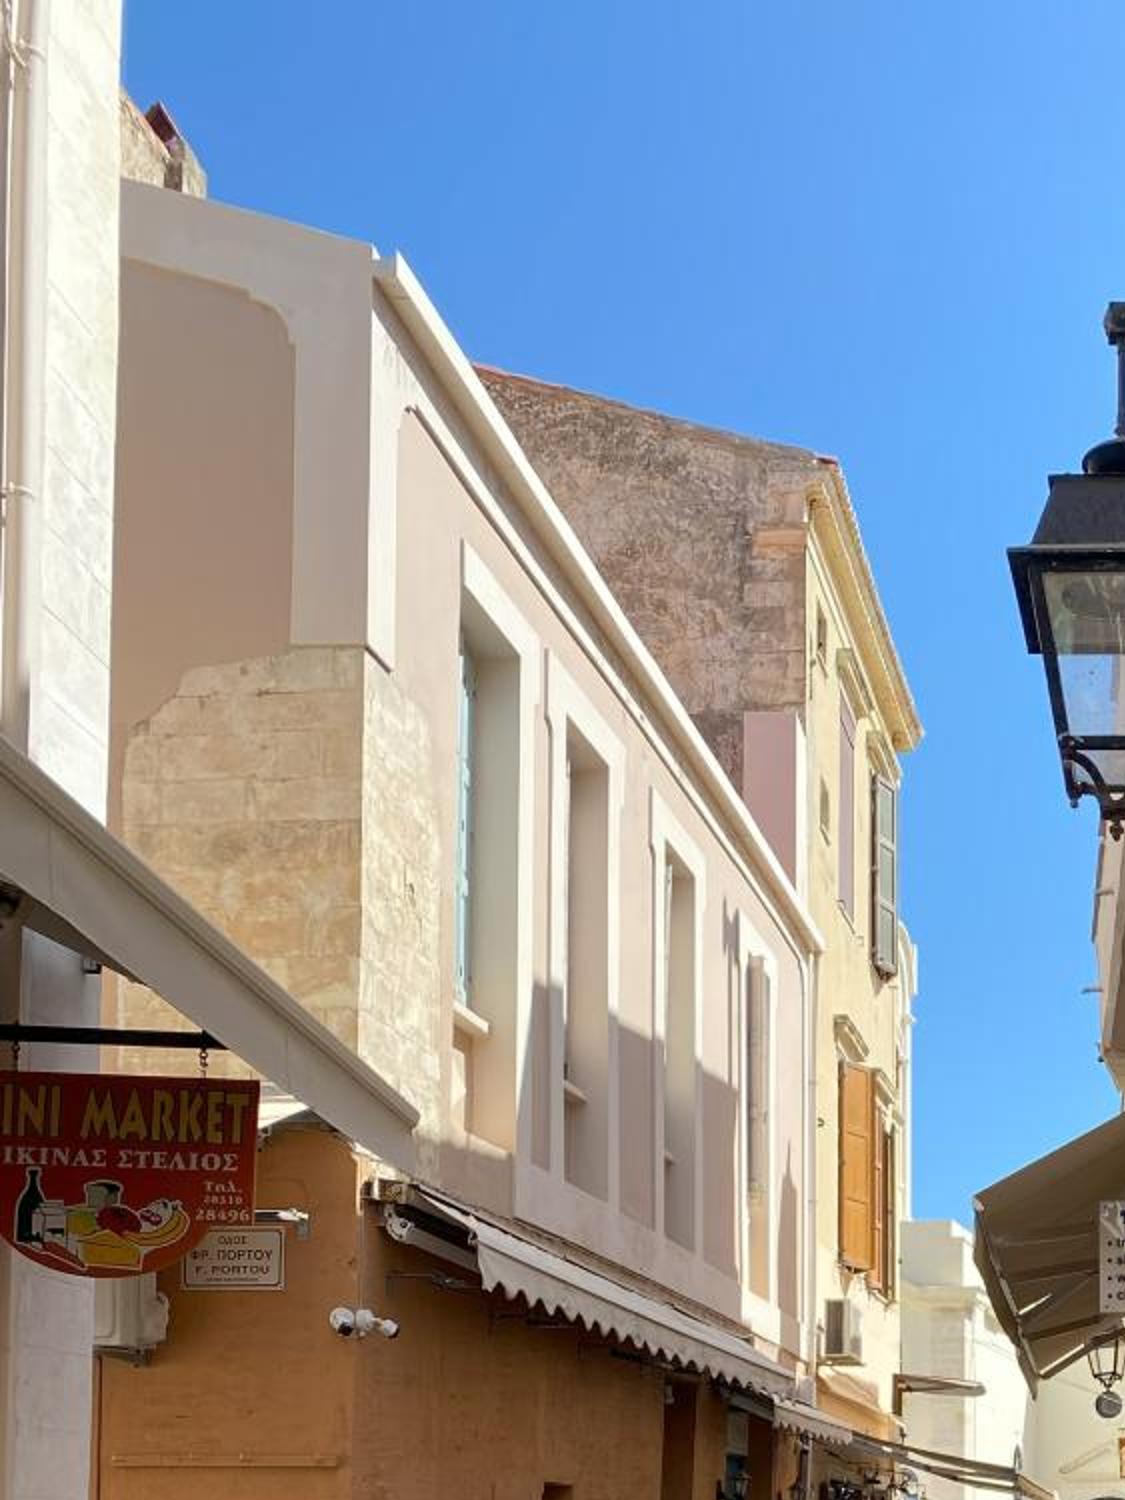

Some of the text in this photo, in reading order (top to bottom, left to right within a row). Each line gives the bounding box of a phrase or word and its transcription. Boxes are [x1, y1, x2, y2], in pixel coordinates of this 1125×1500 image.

[80, 1087, 250, 1144] MARKET
[117, 1149, 240, 1171] ΣΤΕΛΙΟΣ
[195, 1208, 250, 1222] 28496
[217, 1249, 273, 1261] ΠΟΡΤΟΥ
[211, 1265, 269, 1275] PORTOU
